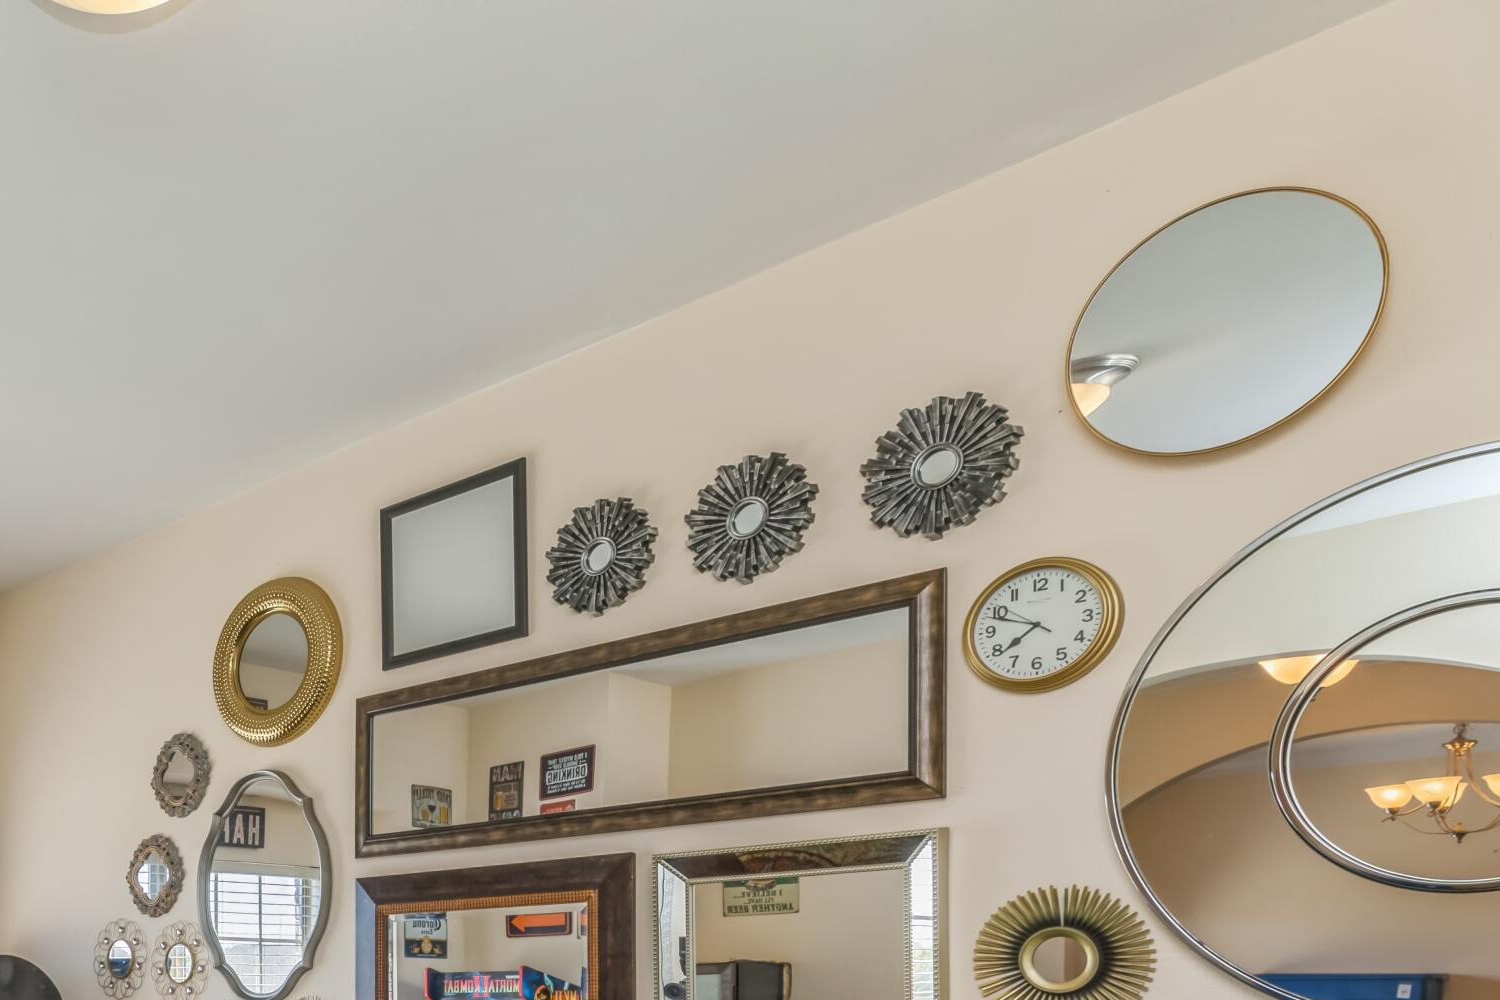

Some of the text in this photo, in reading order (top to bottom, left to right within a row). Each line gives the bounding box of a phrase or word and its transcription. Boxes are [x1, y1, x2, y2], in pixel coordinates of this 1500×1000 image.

[1033, 577, 1049, 592] 12
[1060, 579, 1064, 592] 1
[1010, 588, 1019, 602] 11
[1075, 589, 1087, 603] 2
[992, 605, 1008, 619] 10
[1082, 608, 1093, 622] 3
[985, 625, 996, 638] 9
[1073, 630, 1086, 643] 4
[991, 644, 1003, 657] 8
[1055, 647, 1067, 661] 5
[1009, 655, 1020, 668] 7
[1031, 656, 1042, 670] 6
